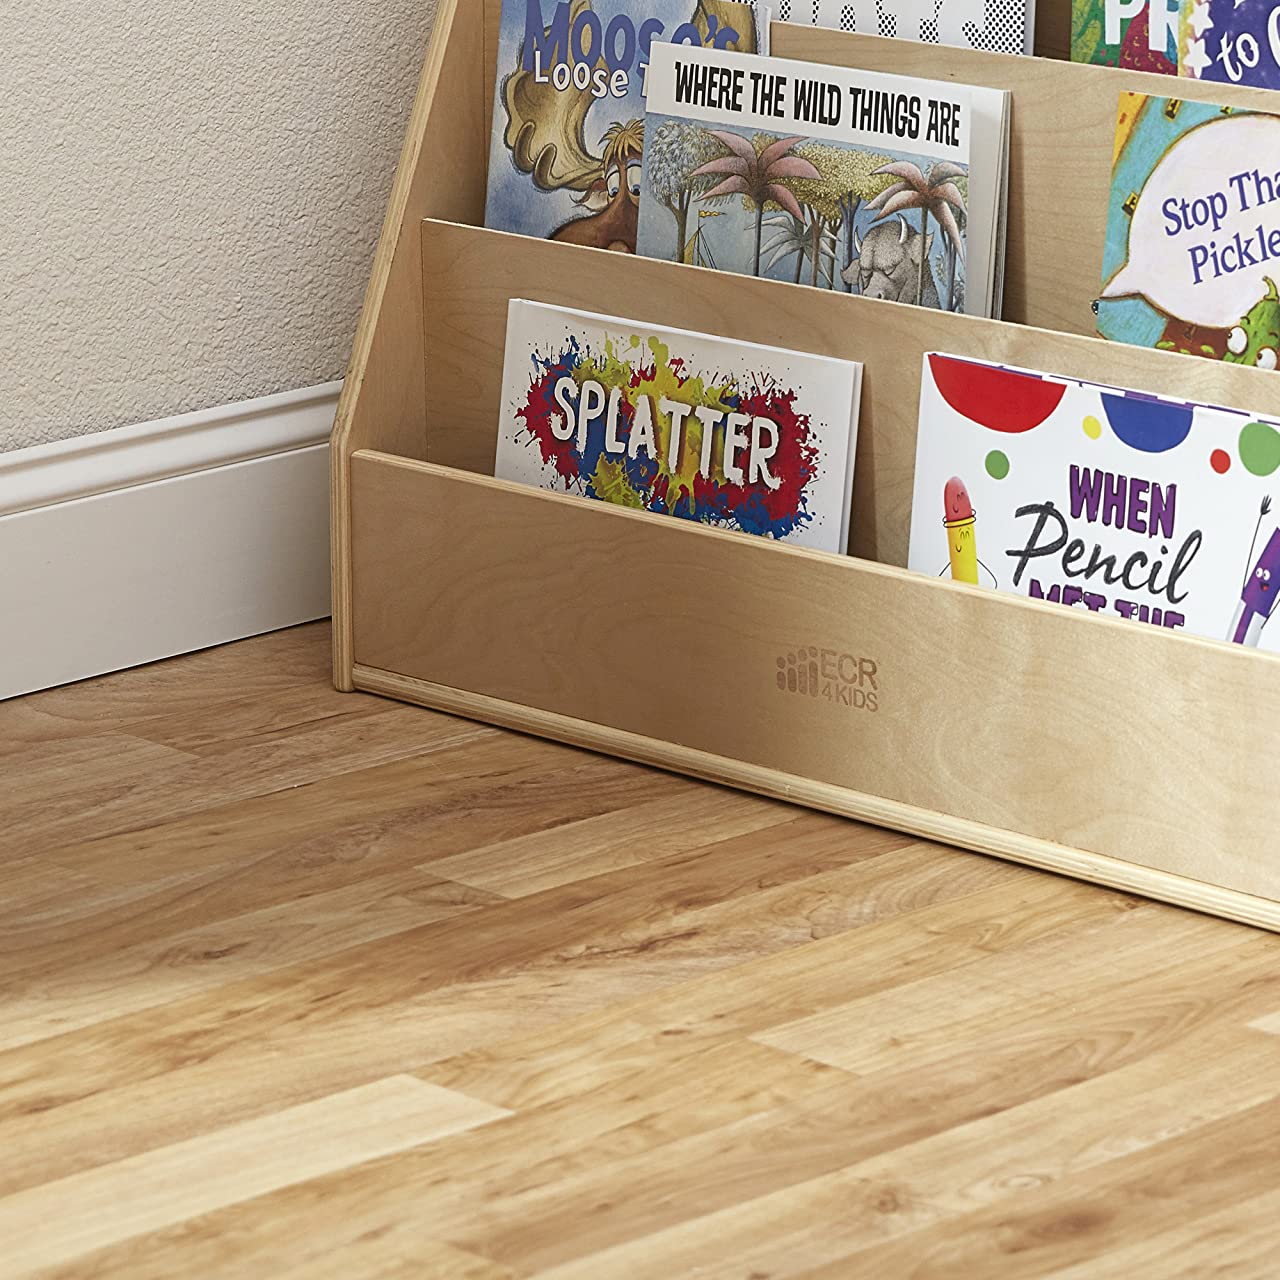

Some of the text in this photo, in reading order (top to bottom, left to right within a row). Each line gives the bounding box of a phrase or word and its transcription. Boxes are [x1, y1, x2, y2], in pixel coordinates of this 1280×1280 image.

[1216, 30, 1260, 83] to
[674, 61, 744, 111] WHERE
[750, 71, 787, 118] THE
[793, 78, 842, 127] WILD
[849, 87, 921, 141] THINGS
[926, 99, 960, 147] ARE
[1161, 190, 1228, 237] Stop
[549, 376, 782, 491] SPLATTER
[1069, 464, 1178, 539] WHEN
[1005, 501, 1203, 604] Pencil
[820, 648, 878, 691] ECR
